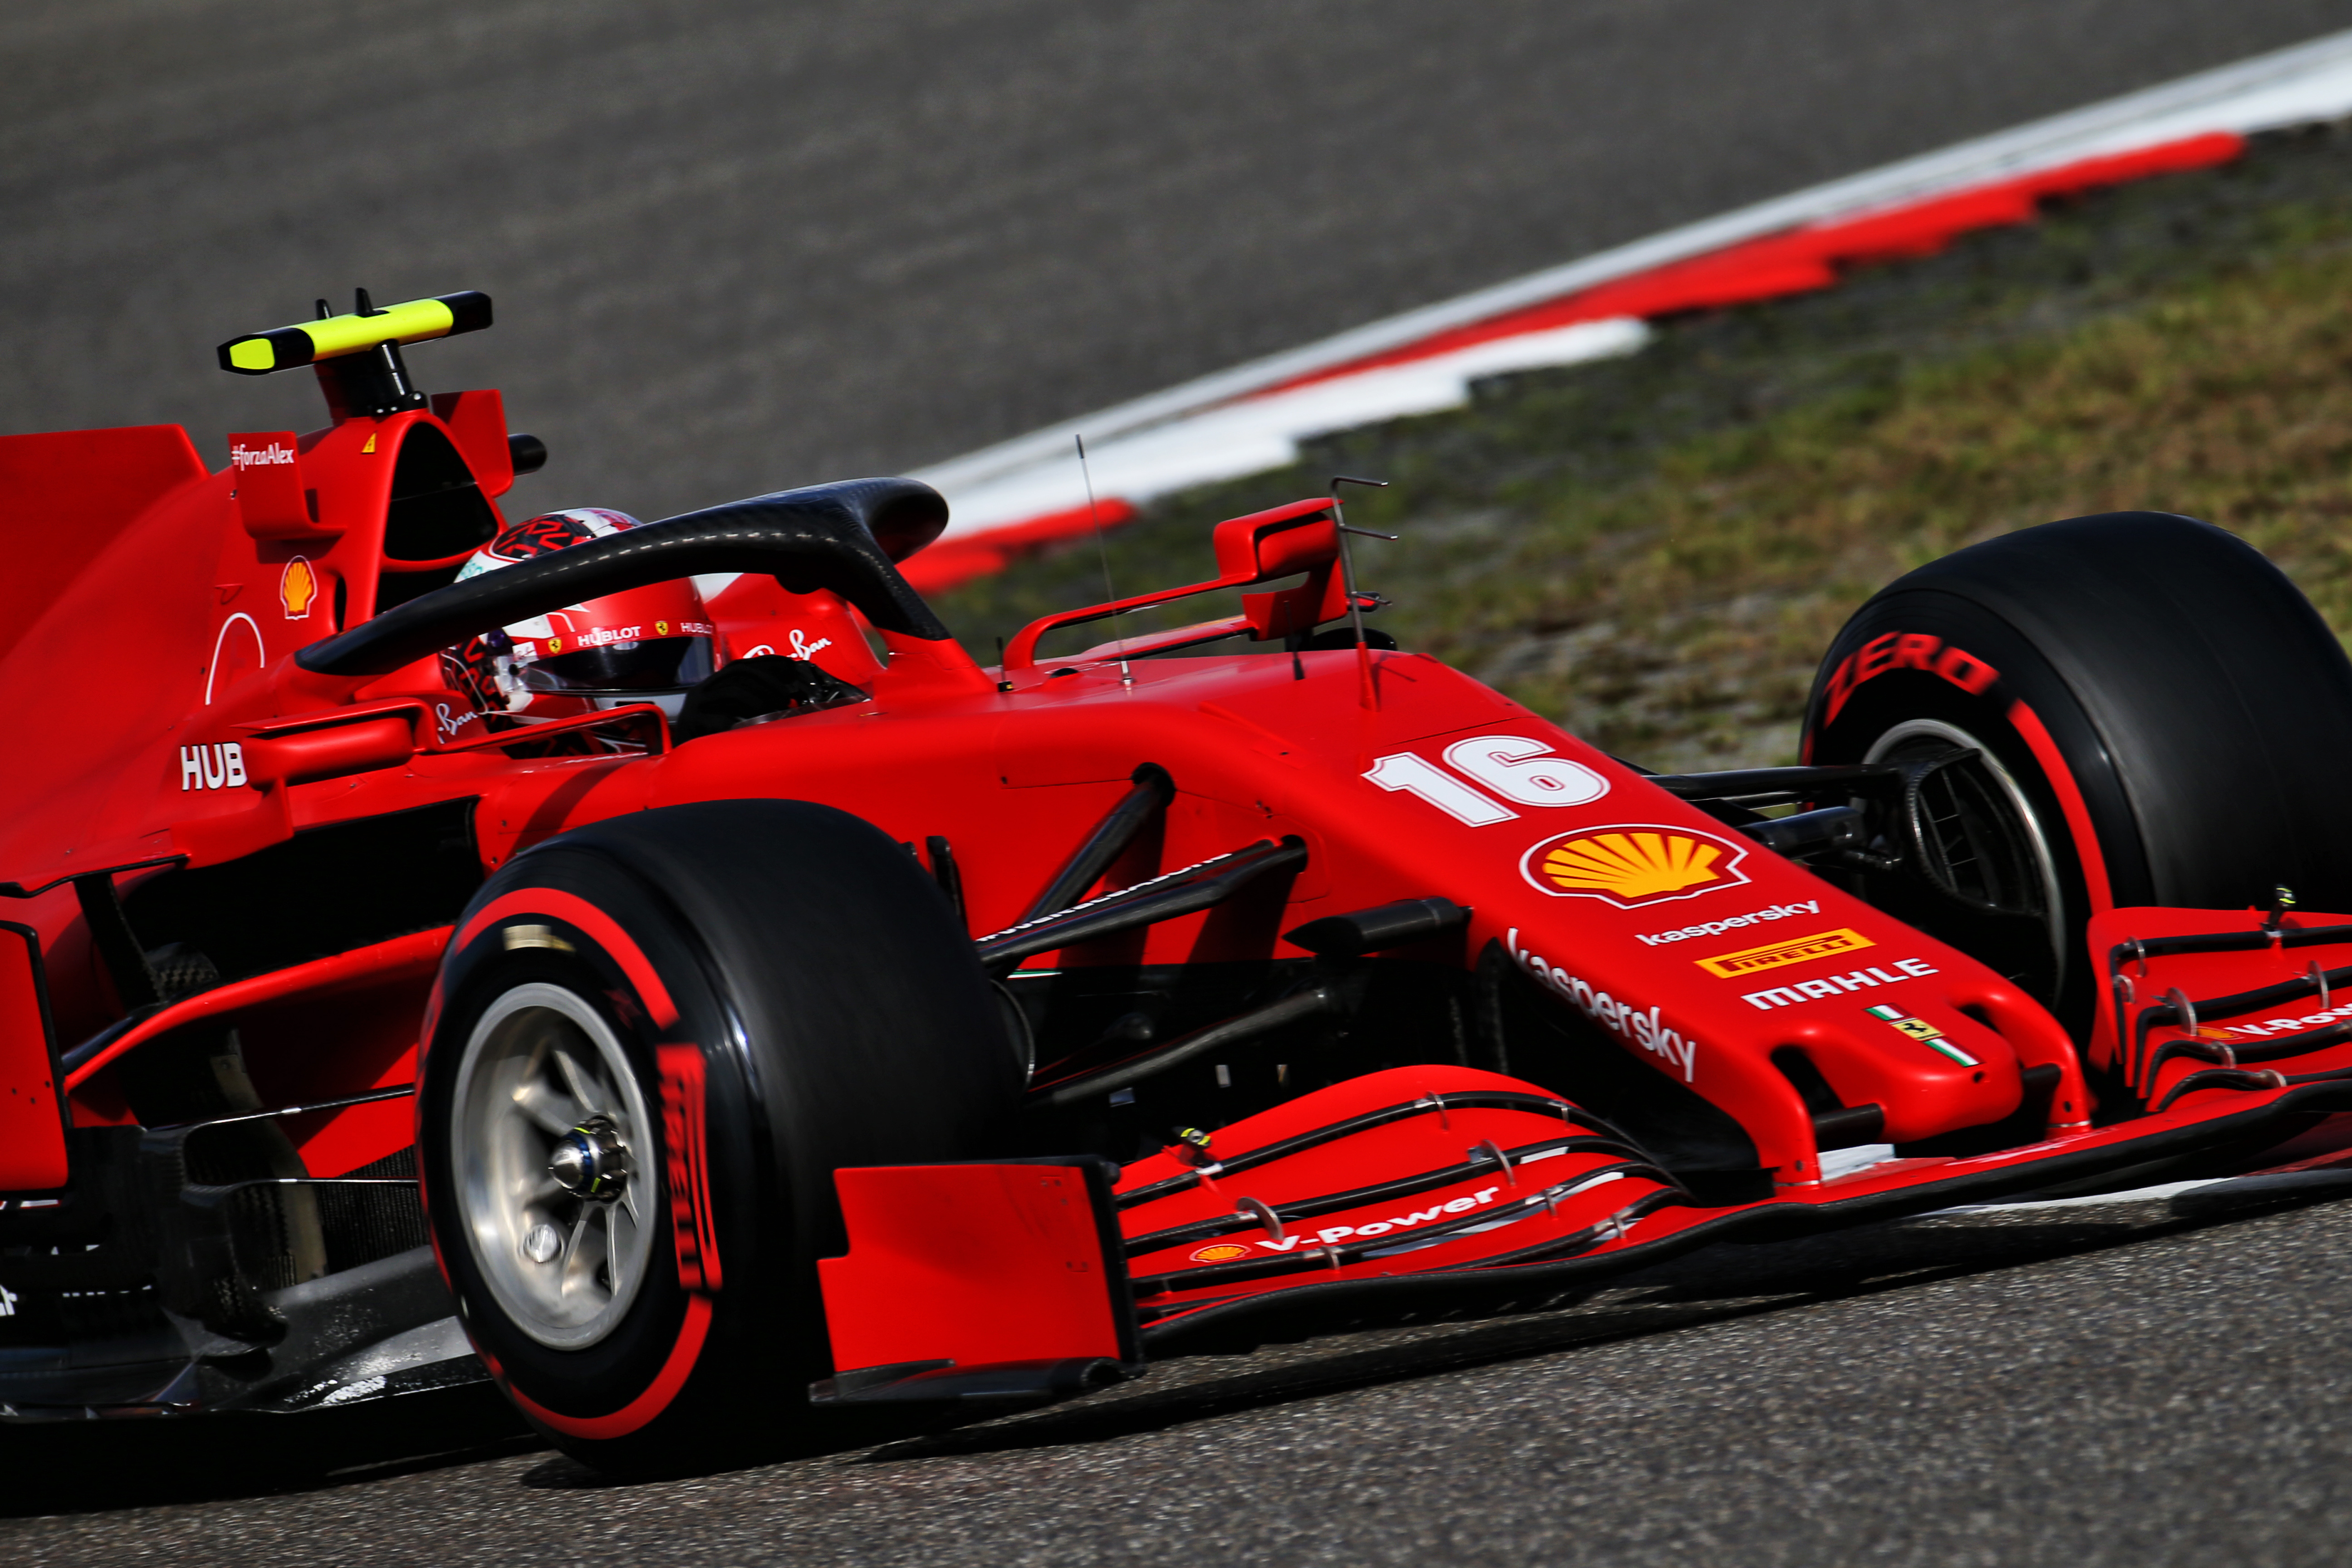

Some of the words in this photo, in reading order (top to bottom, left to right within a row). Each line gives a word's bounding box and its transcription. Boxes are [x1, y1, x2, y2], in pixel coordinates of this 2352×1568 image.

[231, 442, 294, 471] #forzaAlex
[577, 626, 641, 646] HUBLOT
[1823, 631, 2001, 729] ZERO
[1360, 735, 1611, 827] 16
[1634, 900, 1820, 946] kaspersky
[1714, 935, 1854, 972] PIRELLI
[1507, 927, 1696, 1083] kaspersky
[1740, 958, 1940, 1010] MAHLE
[1254, 1186, 1499, 1251] V-Power
